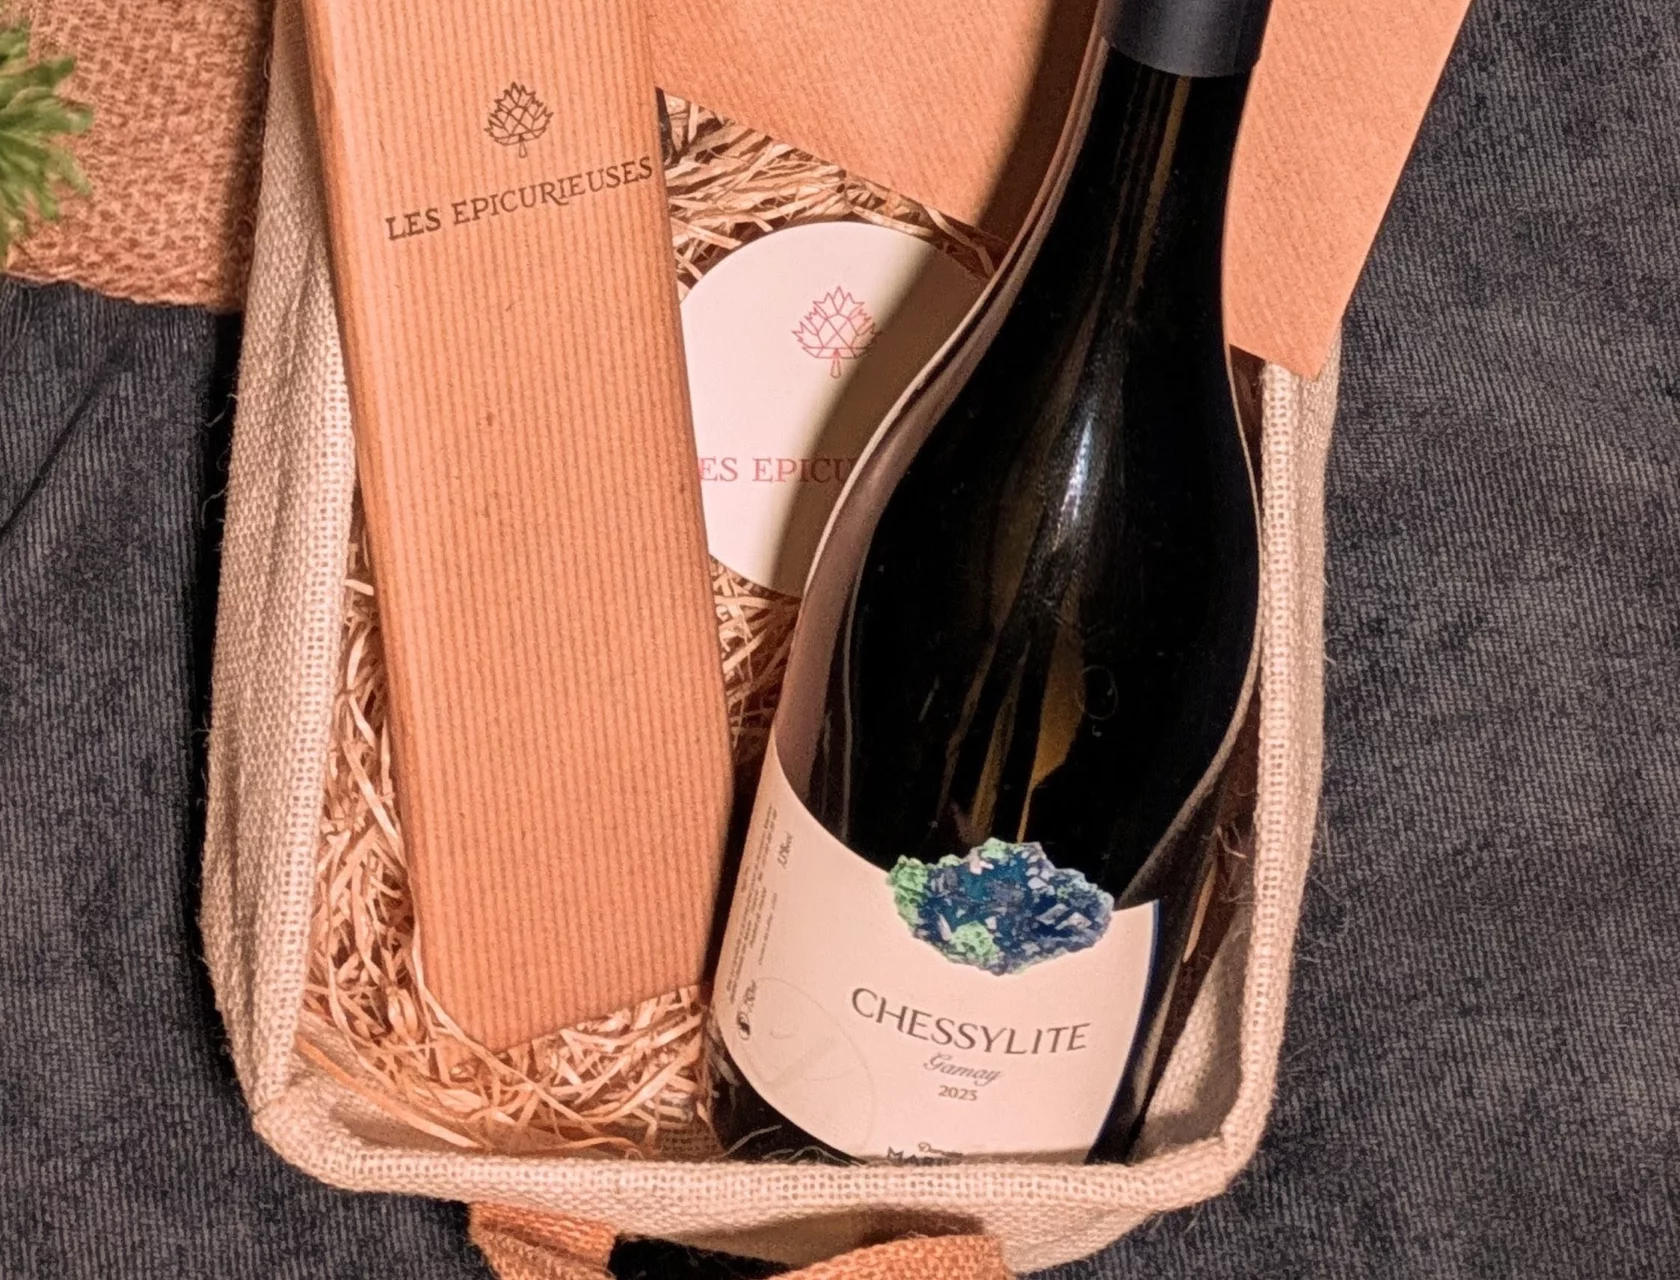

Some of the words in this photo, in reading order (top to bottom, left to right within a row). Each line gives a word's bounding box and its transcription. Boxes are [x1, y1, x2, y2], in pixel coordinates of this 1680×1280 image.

[385, 208, 441, 240] LES
[450, 156, 653, 225] EPICURIEUSES
[698, 456, 738, 482] ES
[851, 987, 1091, 1055] CHESSYLITE
[923, 1052, 1002, 1087] Gamay
